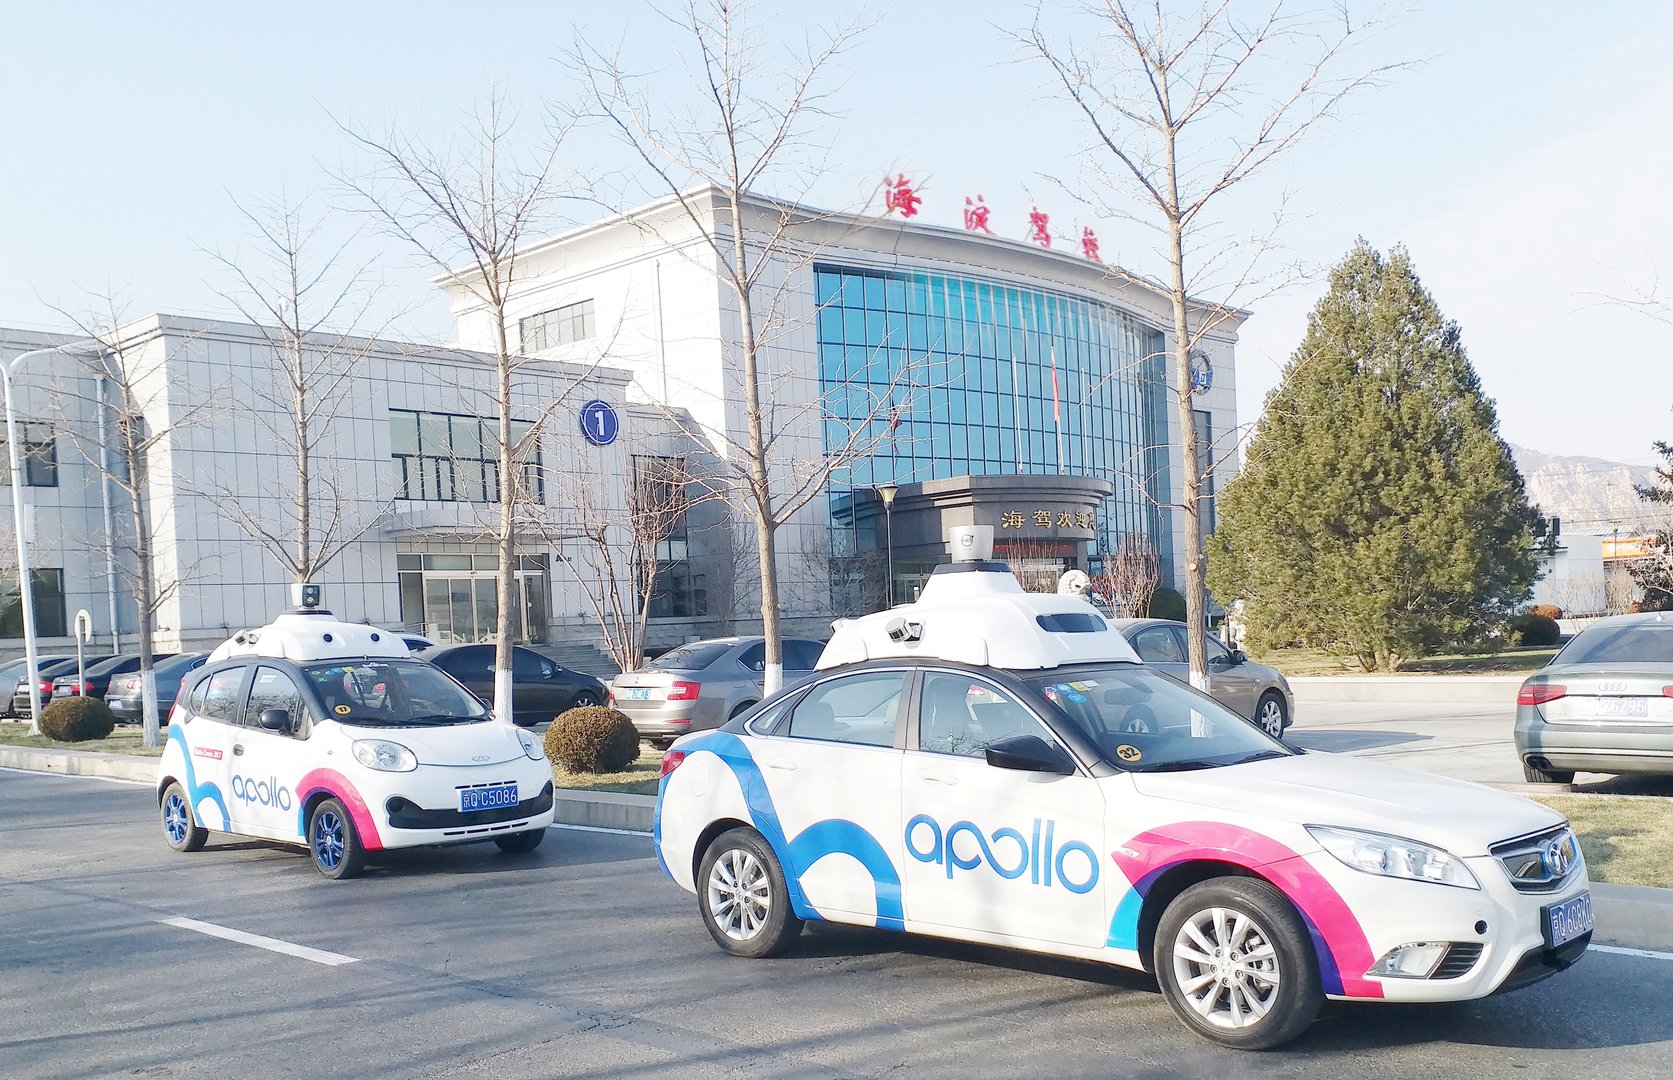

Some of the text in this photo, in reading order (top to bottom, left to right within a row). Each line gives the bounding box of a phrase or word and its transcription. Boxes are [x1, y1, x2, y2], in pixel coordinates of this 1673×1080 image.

[595, 410, 605, 436] 1
[1118, 747, 1139, 759] 32
[231, 774, 291, 811] apollo
[904, 813, 1100, 895] apollo
